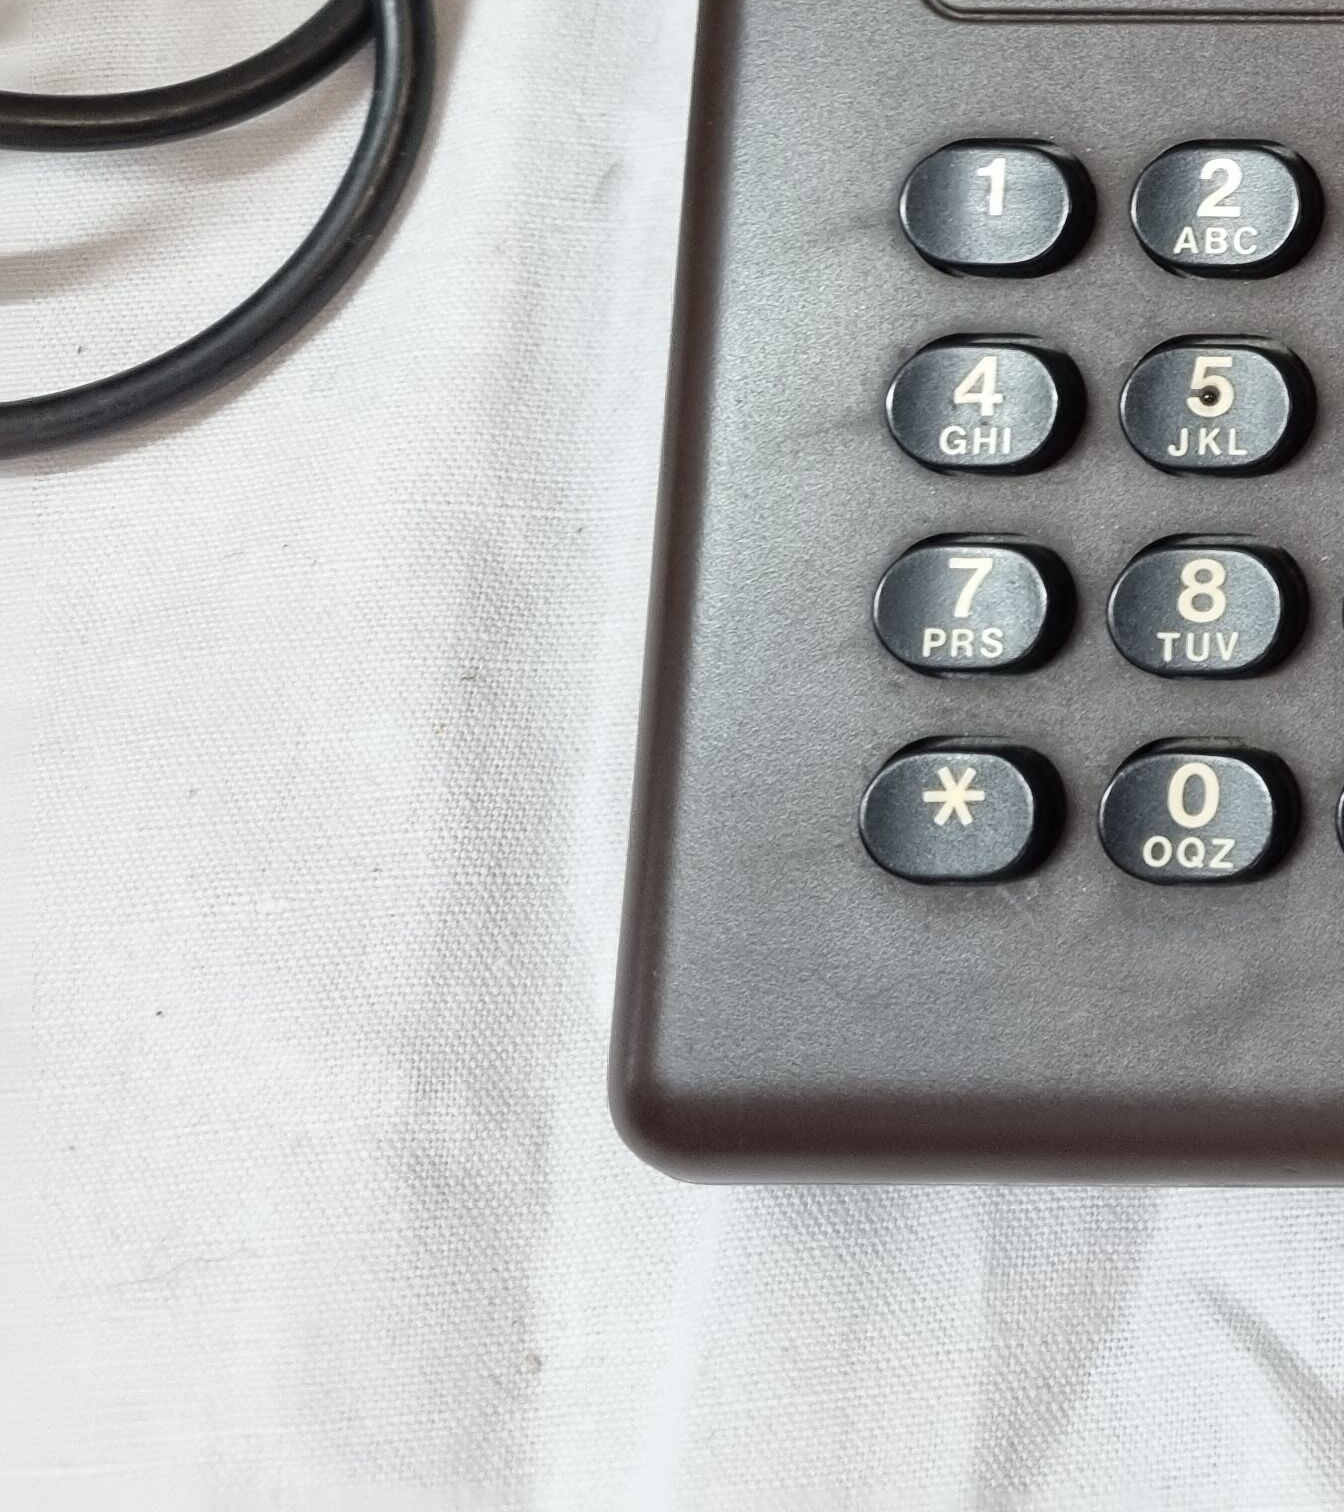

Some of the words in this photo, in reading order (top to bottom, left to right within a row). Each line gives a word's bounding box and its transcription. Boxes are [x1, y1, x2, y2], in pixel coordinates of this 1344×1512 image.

[975, 157, 1008, 217] 1
[1196, 157, 1243, 218] 2
[1173, 226, 1259, 255] ABC
[953, 354, 1004, 418] 4
[1186, 355, 1235, 418] 5
[939, 426, 1012, 456] GHI
[1167, 429, 1248, 458] JKL
[948, 557, 994, 618] 7
[1177, 558, 1227, 623] 8
[921, 628, 1004, 658] PRS
[1156, 631, 1240, 662] TUV
[1166, 762, 1220, 828] 0
[1141, 836, 1235, 869] OQZ
